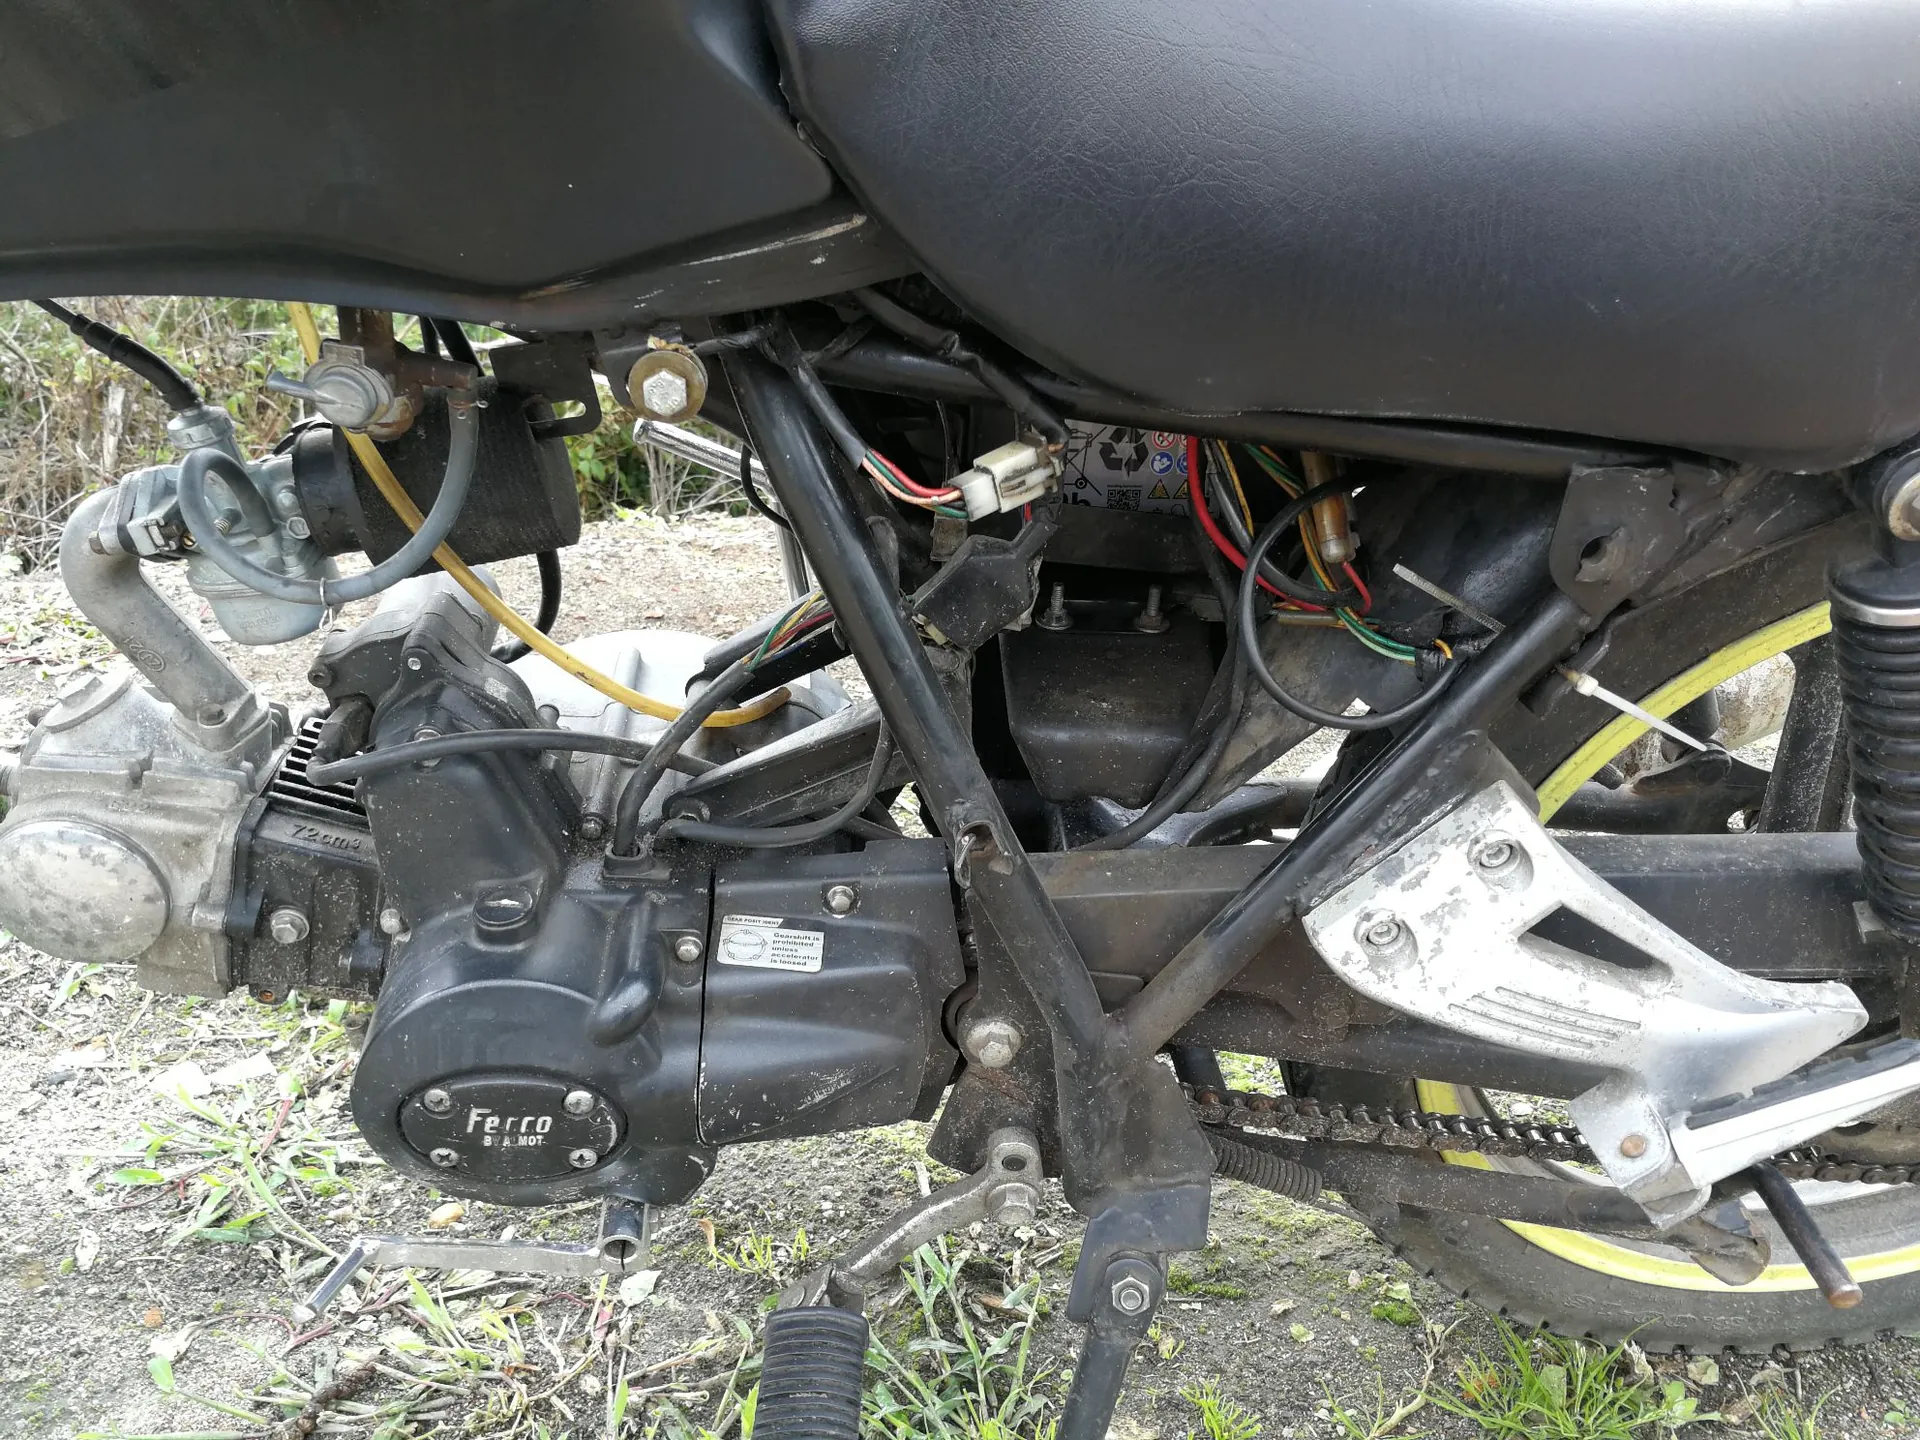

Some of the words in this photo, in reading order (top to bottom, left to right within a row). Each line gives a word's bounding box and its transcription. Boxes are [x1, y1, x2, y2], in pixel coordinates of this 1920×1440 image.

[773, 932, 811, 940] Gearshift
[772, 939, 814, 947] prohibited
[770, 952, 819, 961] accelerator
[466, 1107, 553, 1133] Ferro
